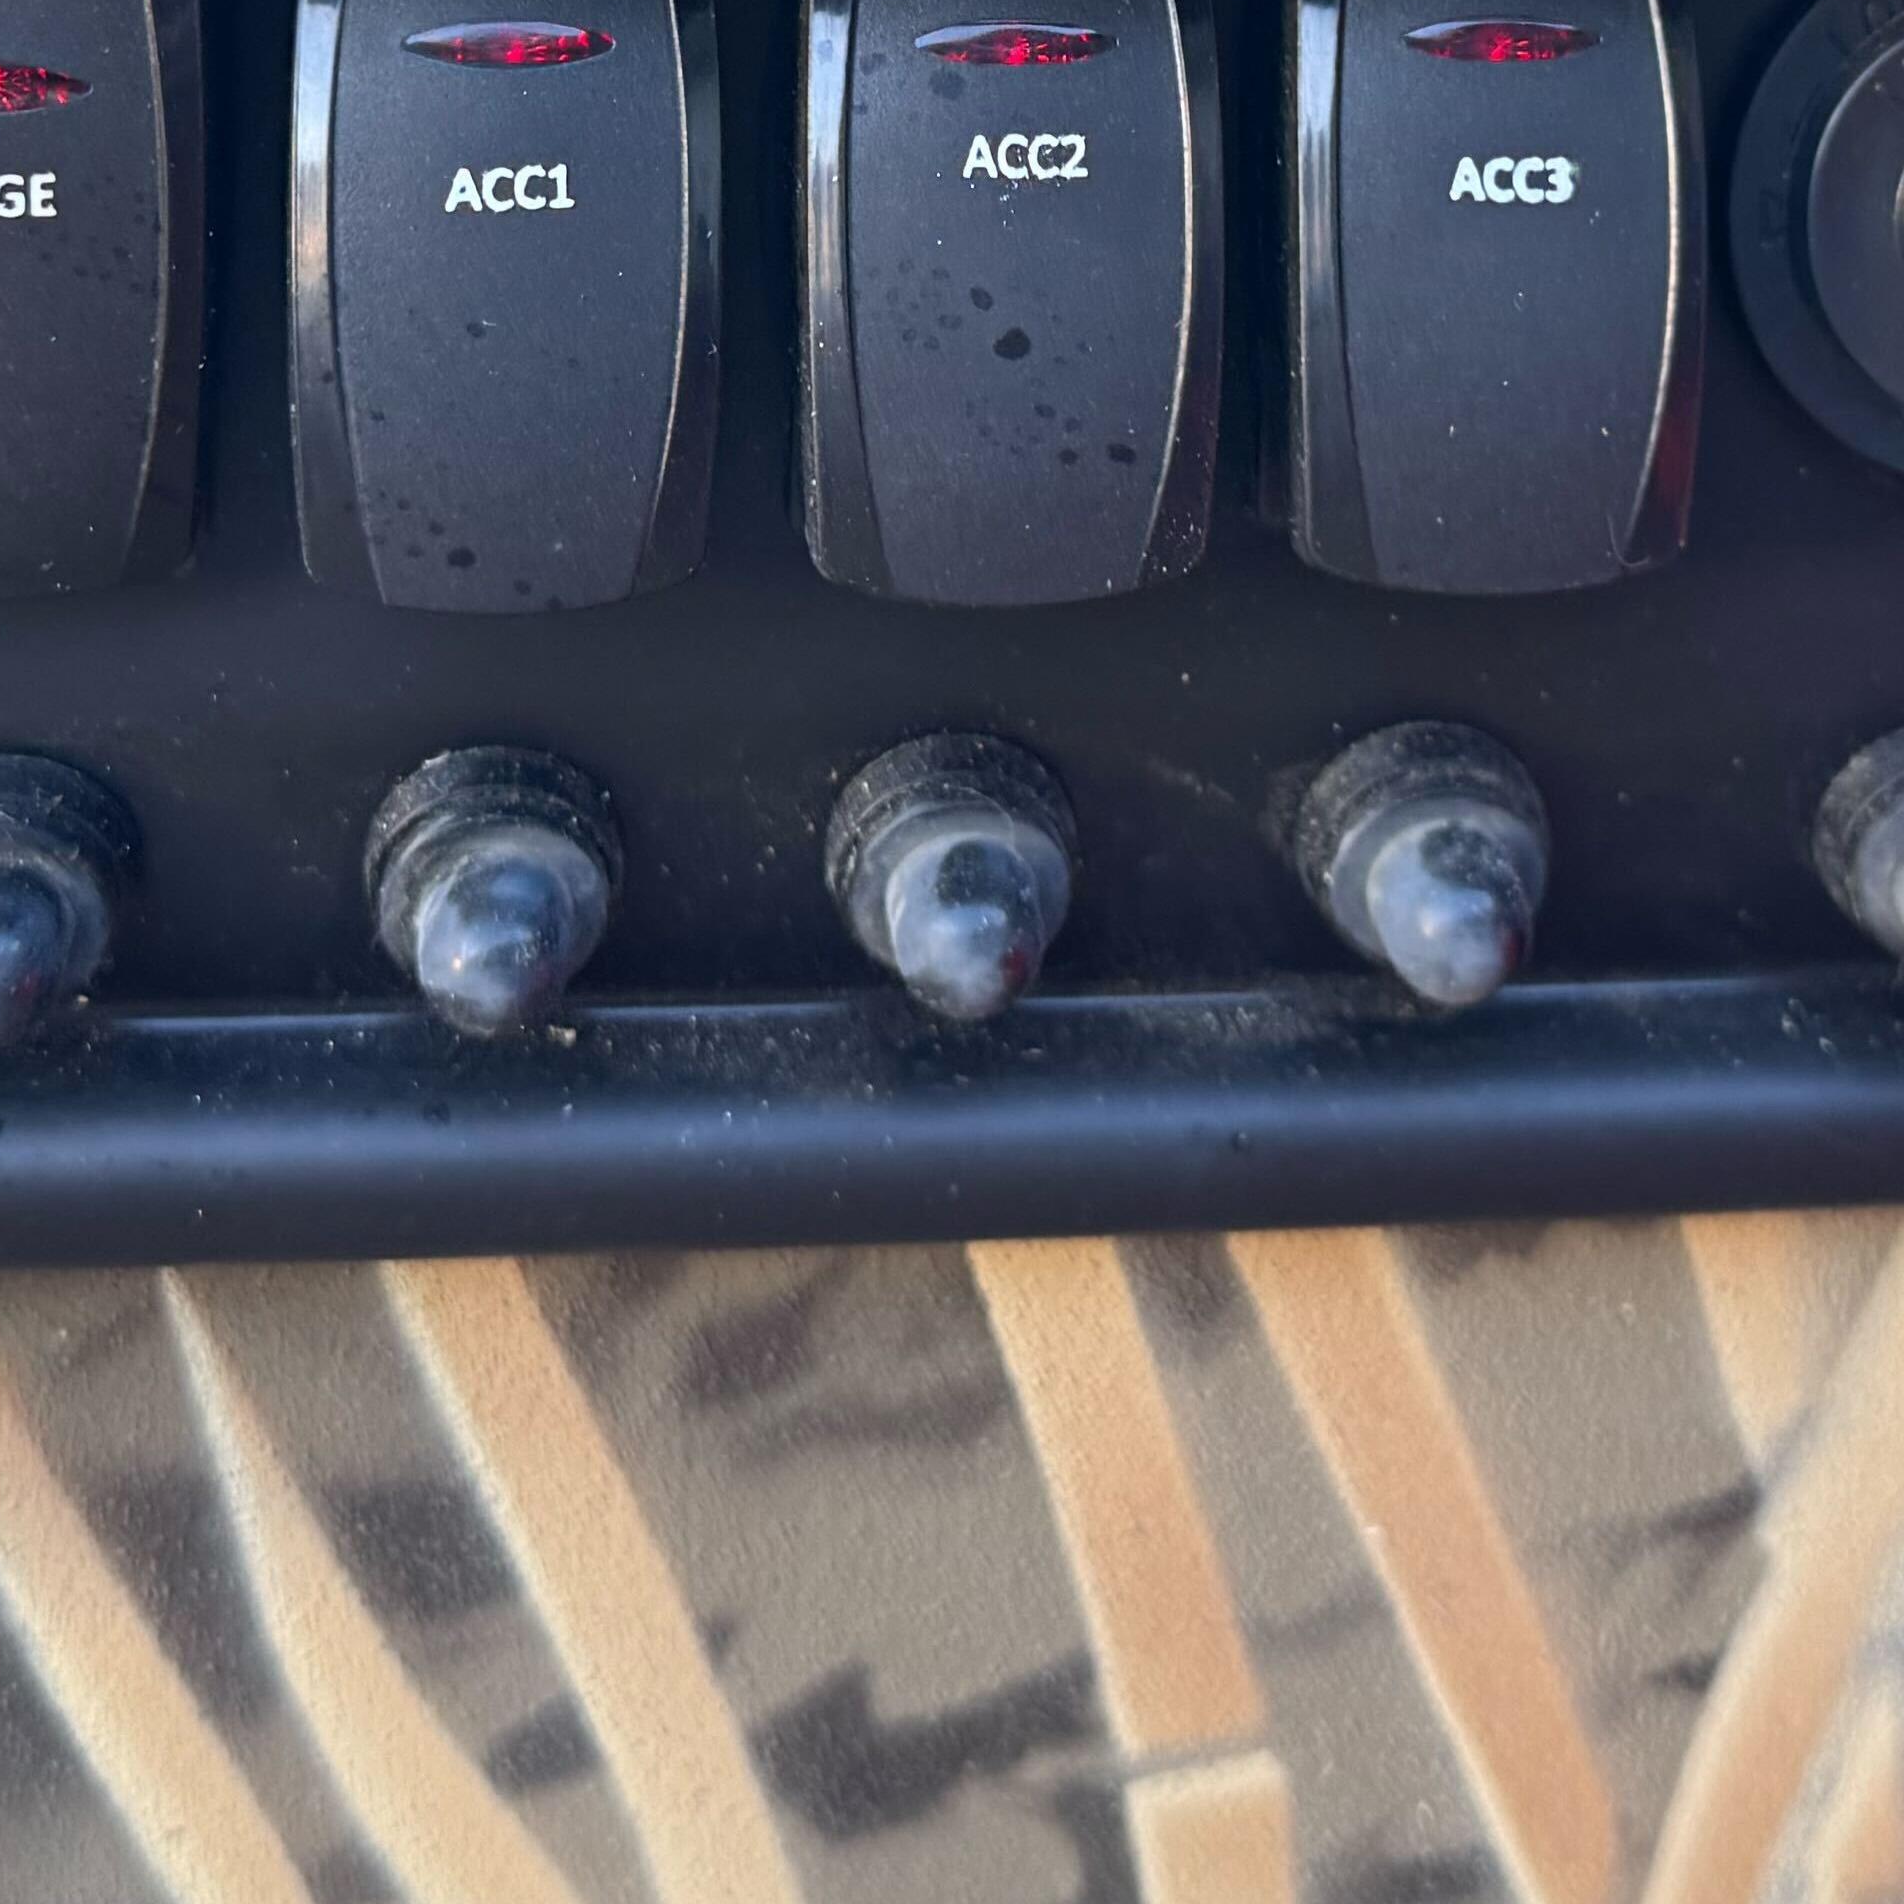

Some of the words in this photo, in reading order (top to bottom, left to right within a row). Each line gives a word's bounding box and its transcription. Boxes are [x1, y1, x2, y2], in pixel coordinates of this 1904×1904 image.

[961, 133, 1090, 182] ACC2
[1448, 155, 1578, 205] ACC3
[444, 163, 576, 214] ACC1
